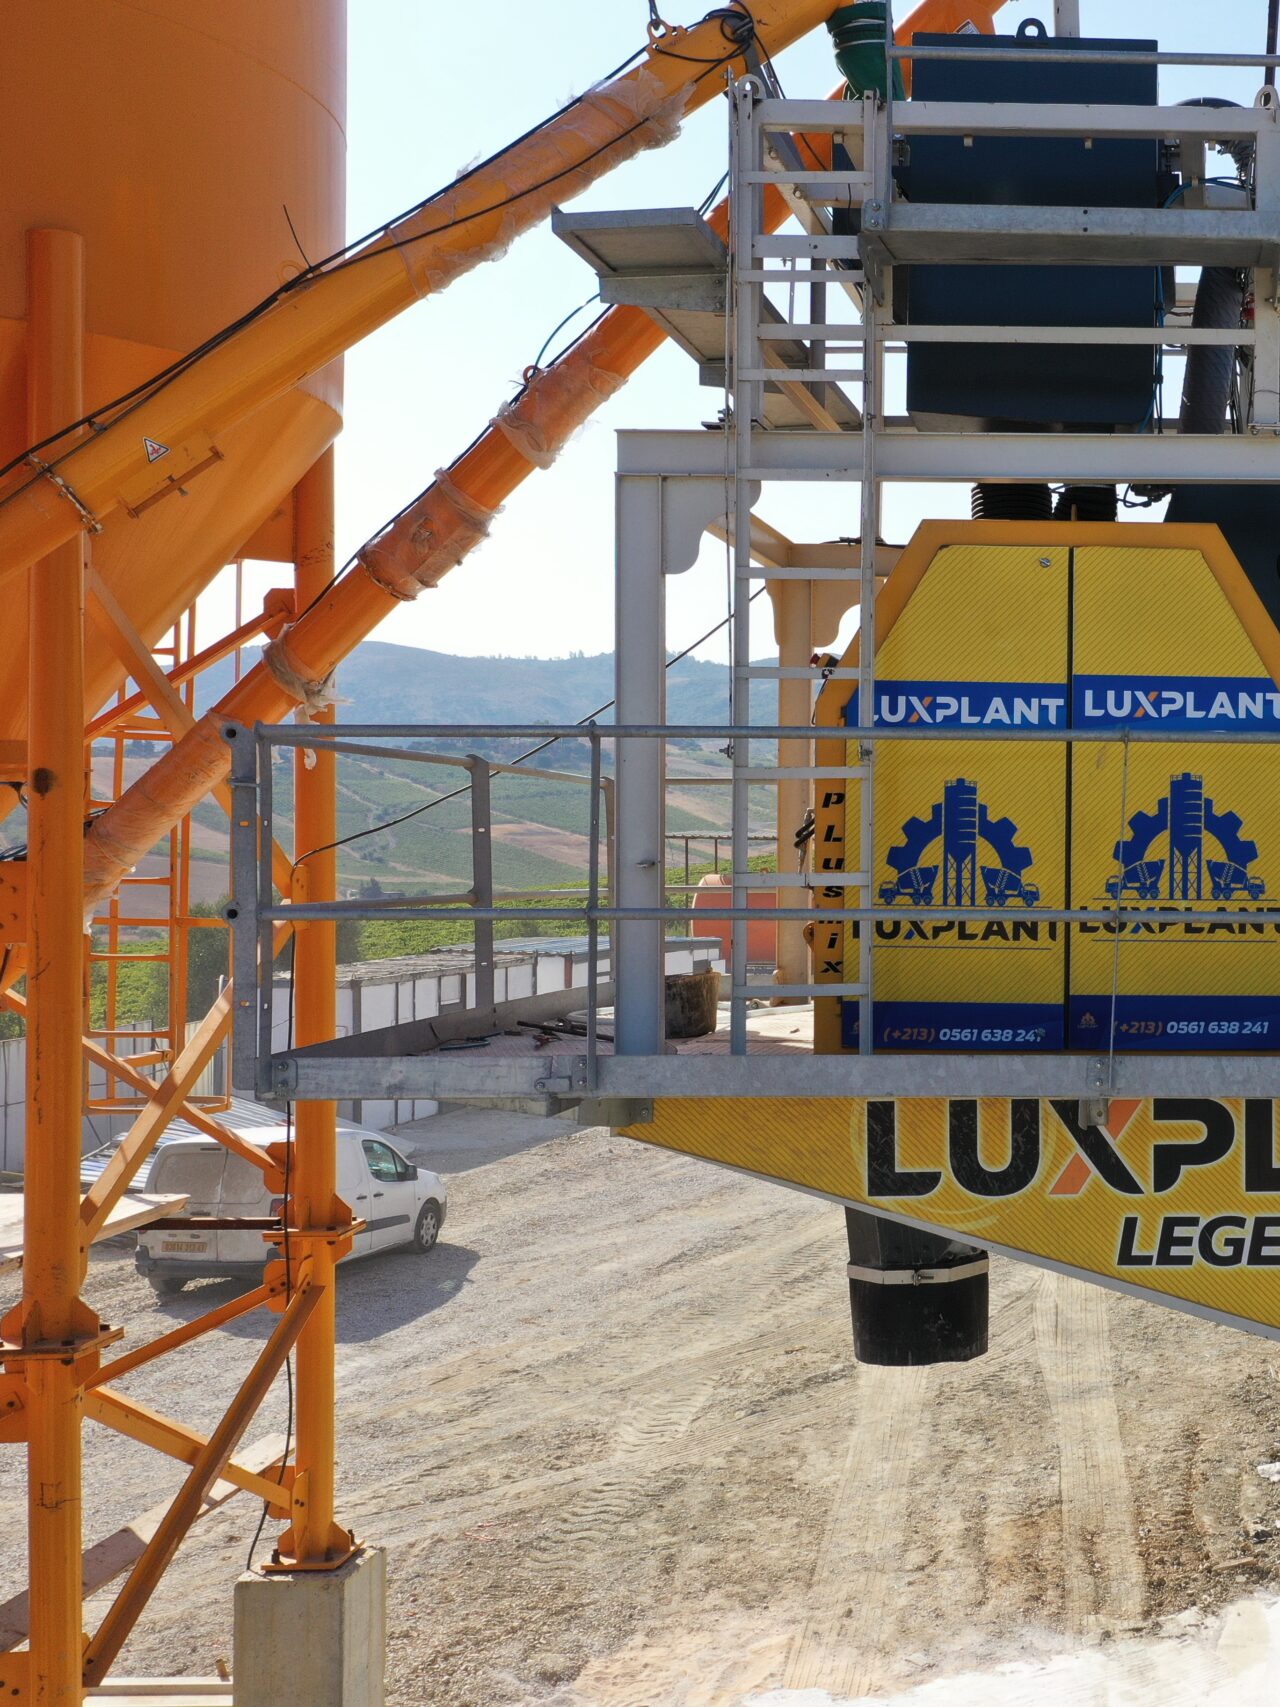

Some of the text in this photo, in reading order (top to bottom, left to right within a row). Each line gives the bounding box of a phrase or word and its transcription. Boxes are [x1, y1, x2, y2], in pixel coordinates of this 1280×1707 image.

[872, 695, 1065, 726] UXPLANT
[882, 1027, 936, 1043] (+213)
[939, 1027, 977, 1042] 0561
[980, 1028, 1013, 1042] 638
[1166, 1021, 1205, 1034] 0561
[1207, 1021, 1240, 1034] 638
[1241, 1021, 1269, 1034] 241
